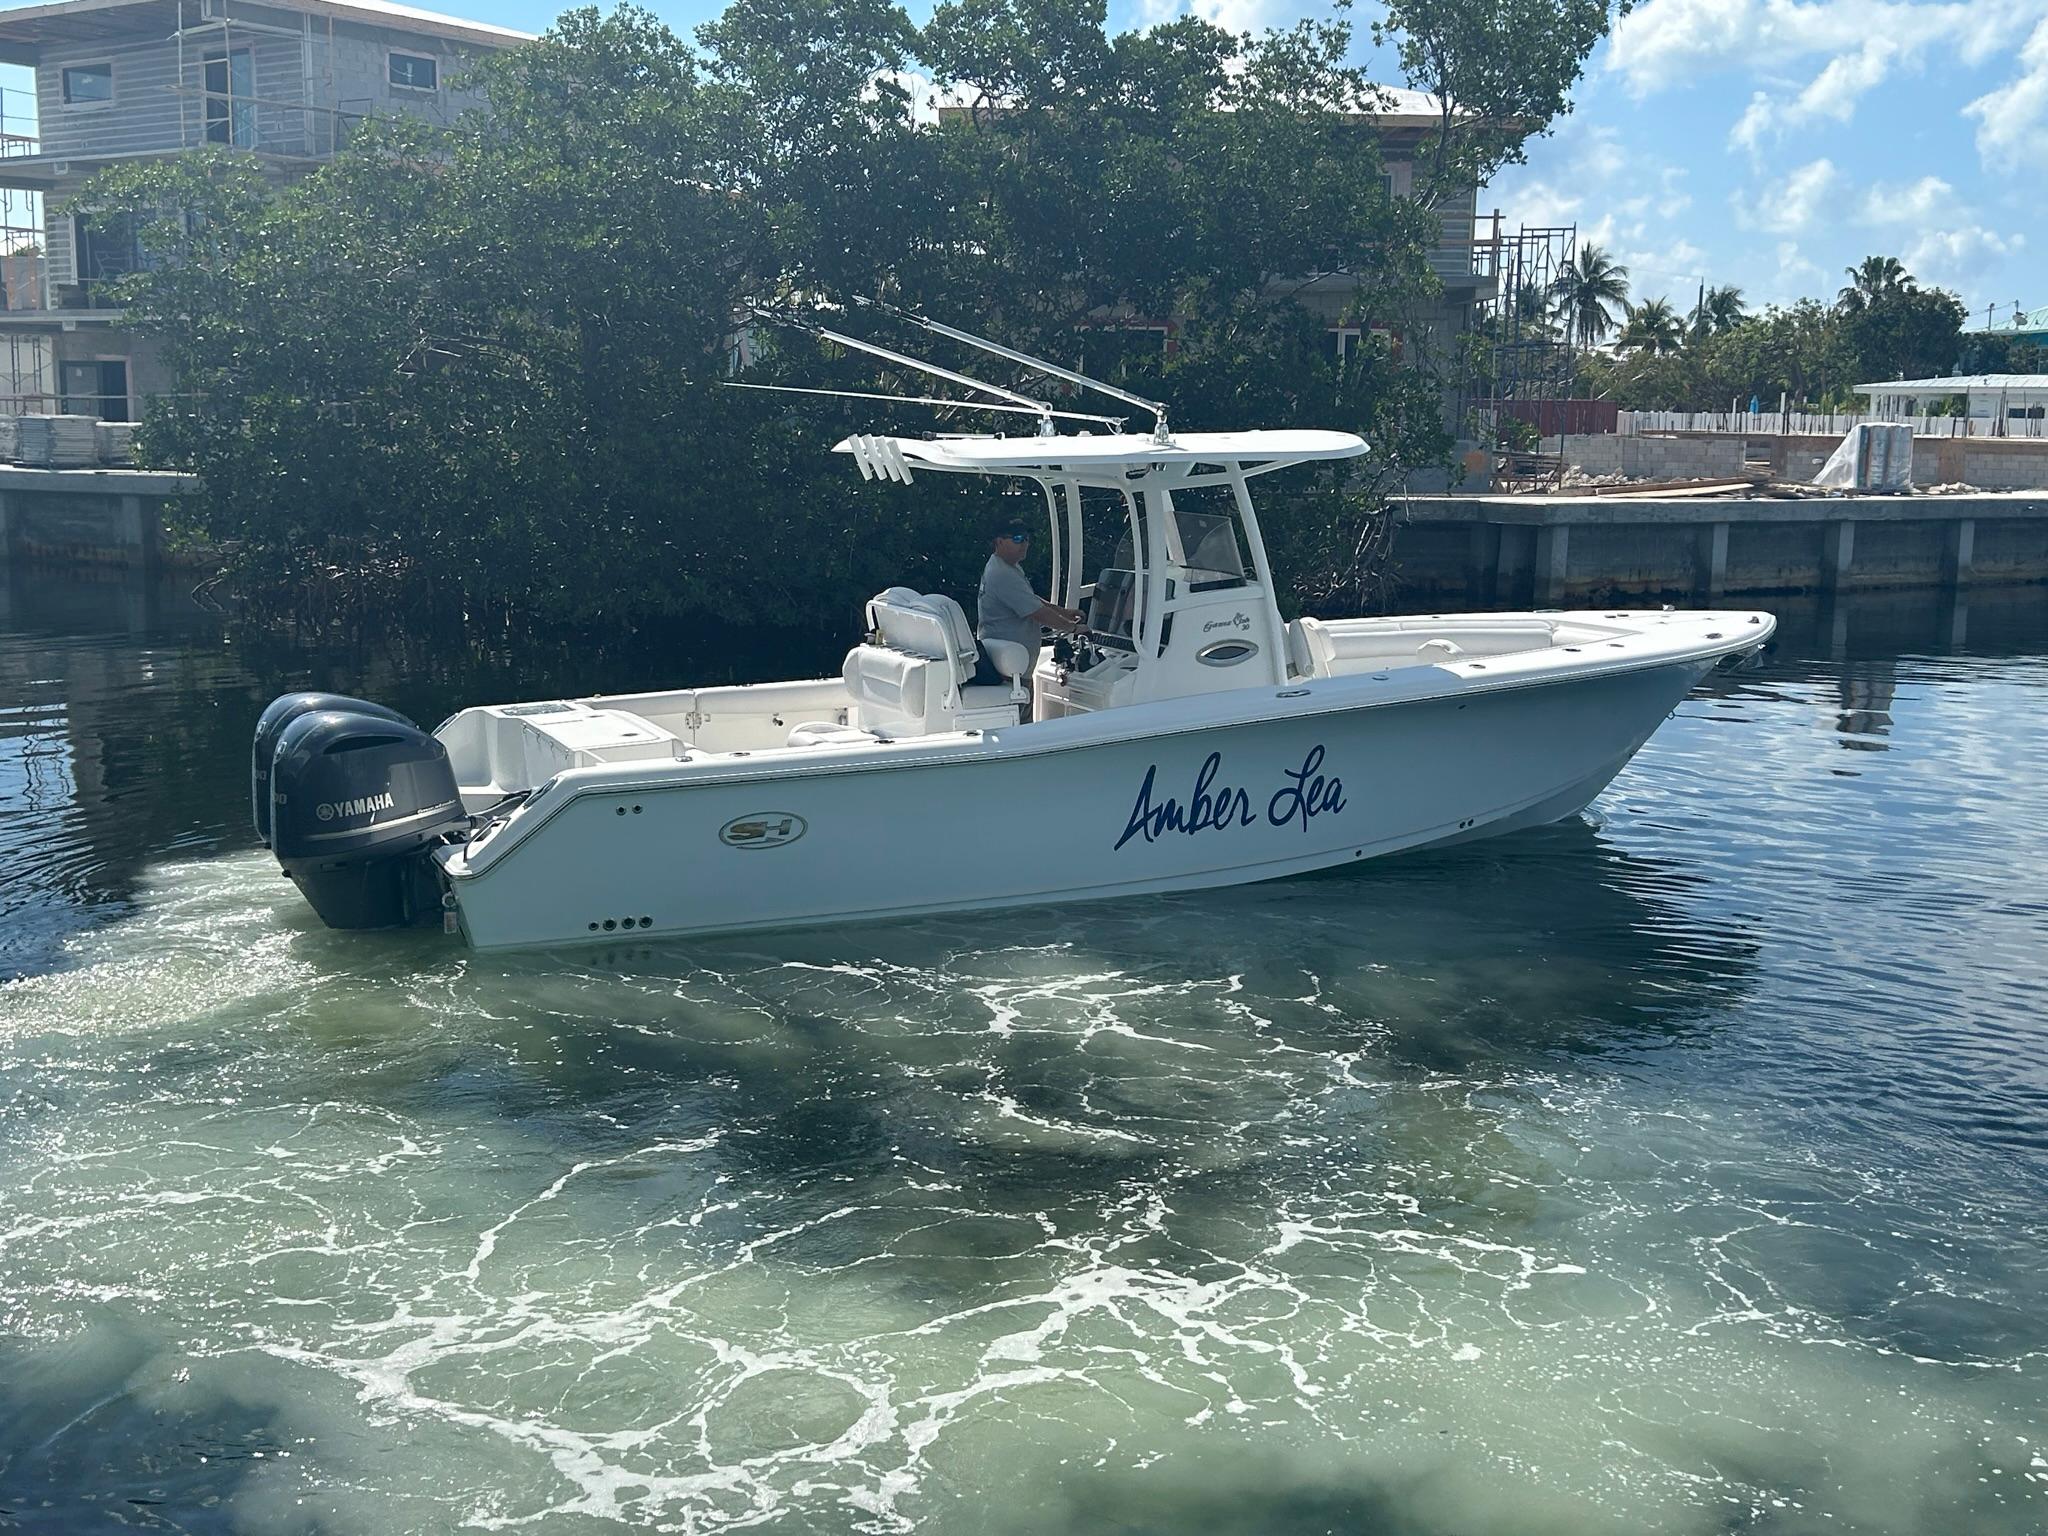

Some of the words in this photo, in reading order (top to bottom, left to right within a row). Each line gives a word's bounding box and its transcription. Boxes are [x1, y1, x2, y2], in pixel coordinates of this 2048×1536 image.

[333, 792, 395, 818] YAMAHA
[1113, 751, 1257, 852] Amber
[1267, 744, 1347, 833] Lea
